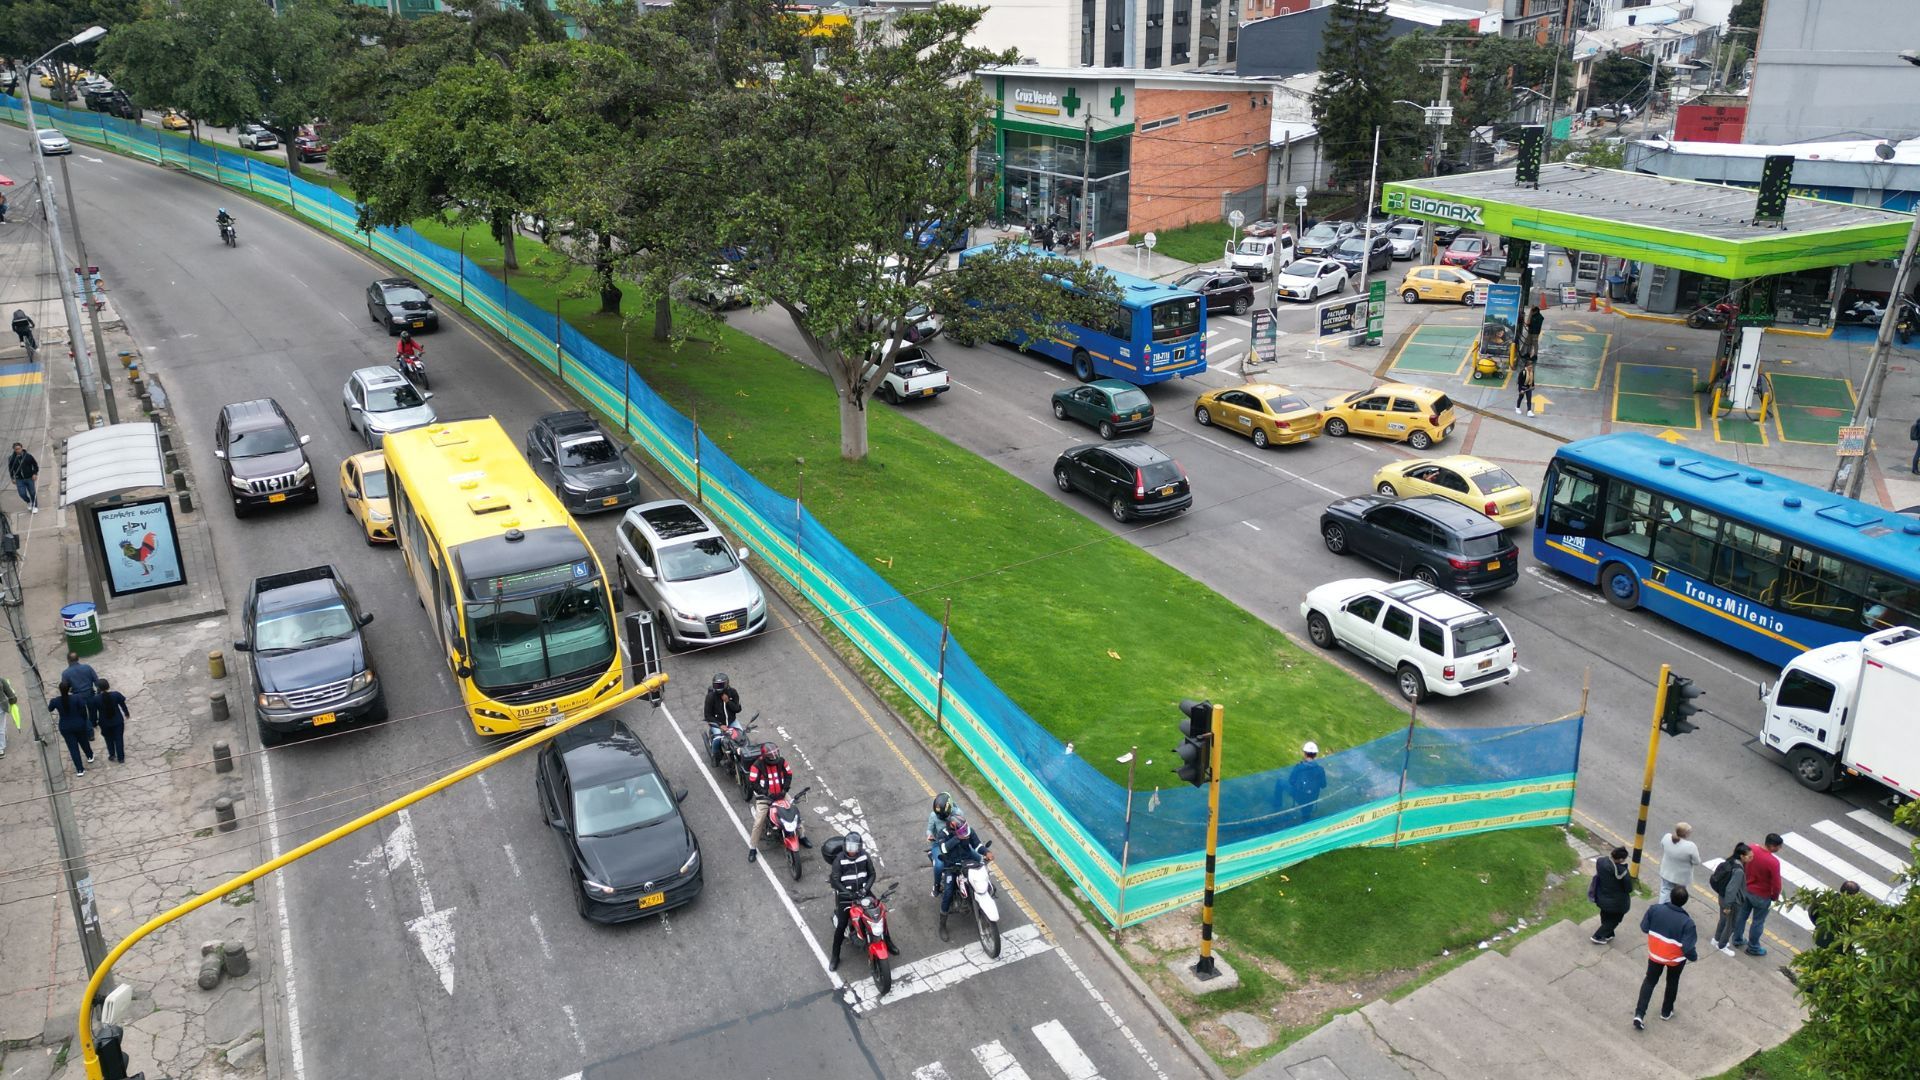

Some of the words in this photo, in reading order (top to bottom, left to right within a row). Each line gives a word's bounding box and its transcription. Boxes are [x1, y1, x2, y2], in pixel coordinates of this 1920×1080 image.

[1408, 196, 1482, 223] BIOMAX
[1326, 308, 1348, 318] FACTURA
[1685, 580, 1784, 632] TransMilenio
